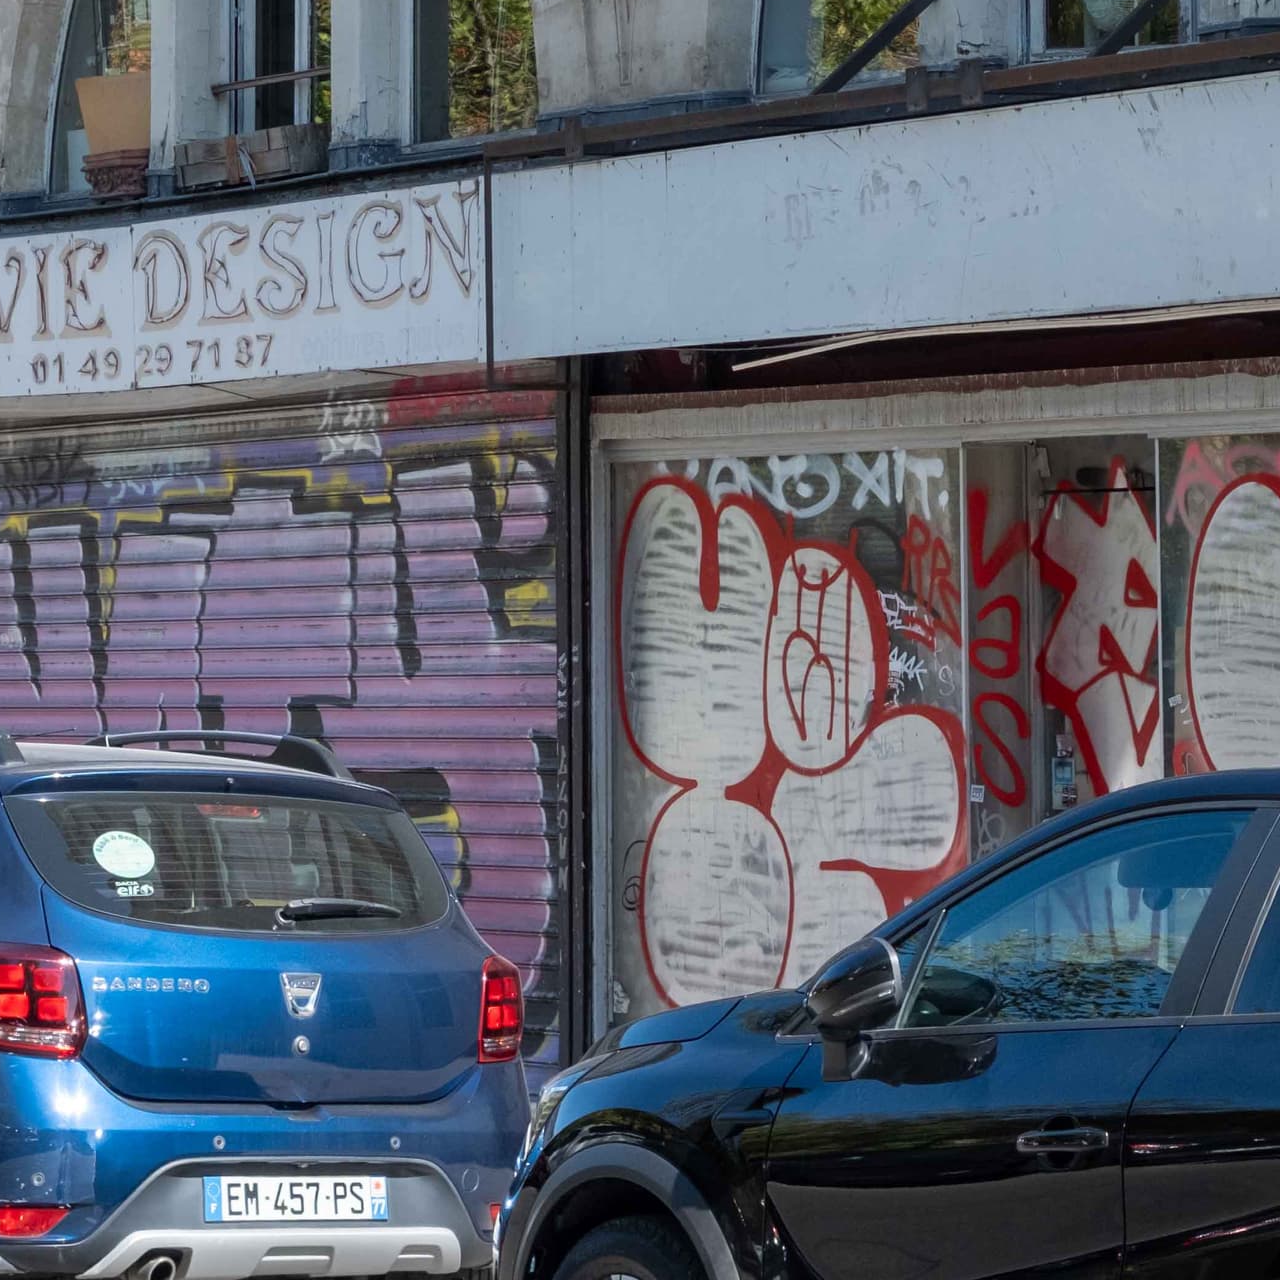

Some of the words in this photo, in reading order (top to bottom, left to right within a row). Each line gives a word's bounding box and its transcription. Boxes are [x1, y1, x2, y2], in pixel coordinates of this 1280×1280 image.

[134, 177, 480, 329] DESIGN
[117, 885, 140, 897] elf
[92, 977, 211, 994] SANDERO
[227, 1182, 365, 1216] EM-457-PS
[372, 1198, 387, 1216] 77
